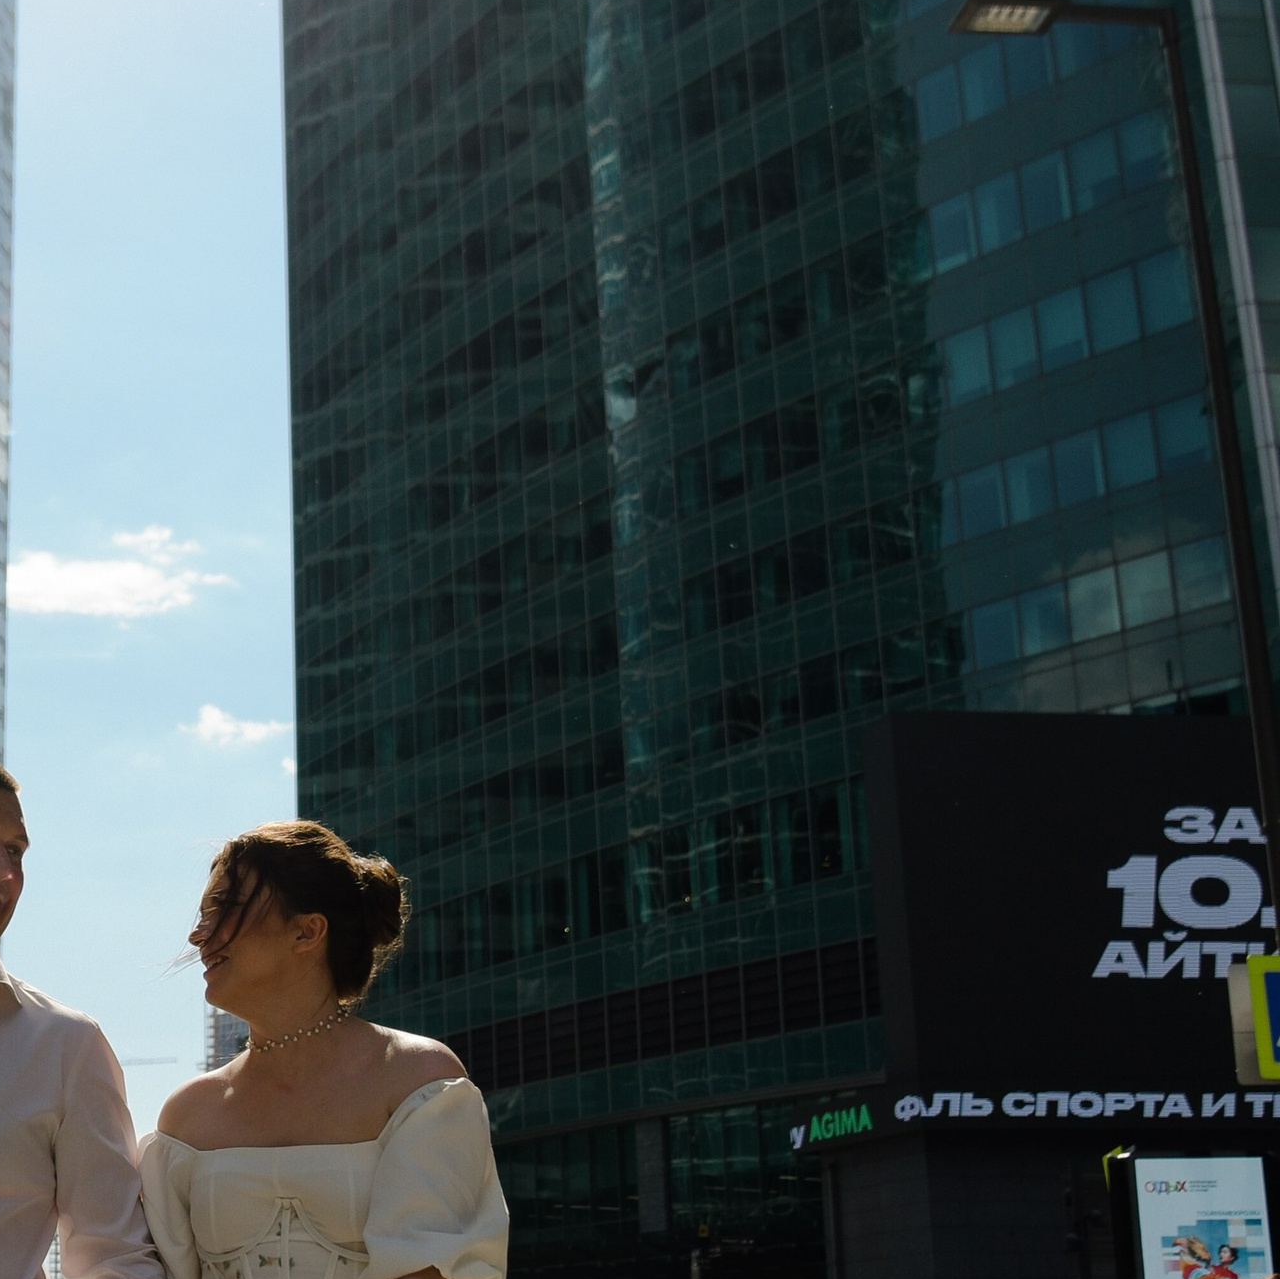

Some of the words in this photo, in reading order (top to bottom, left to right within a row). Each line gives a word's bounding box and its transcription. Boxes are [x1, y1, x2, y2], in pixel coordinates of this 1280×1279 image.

[1163, 806, 1267, 844] ЗА
[809, 1103, 874, 1142] AGIMA
[1001, 1092, 1193, 1118] СПОРТА
[1201, 1093, 1236, 1118] И
[1245, 1093, 1280, 1118] Т
